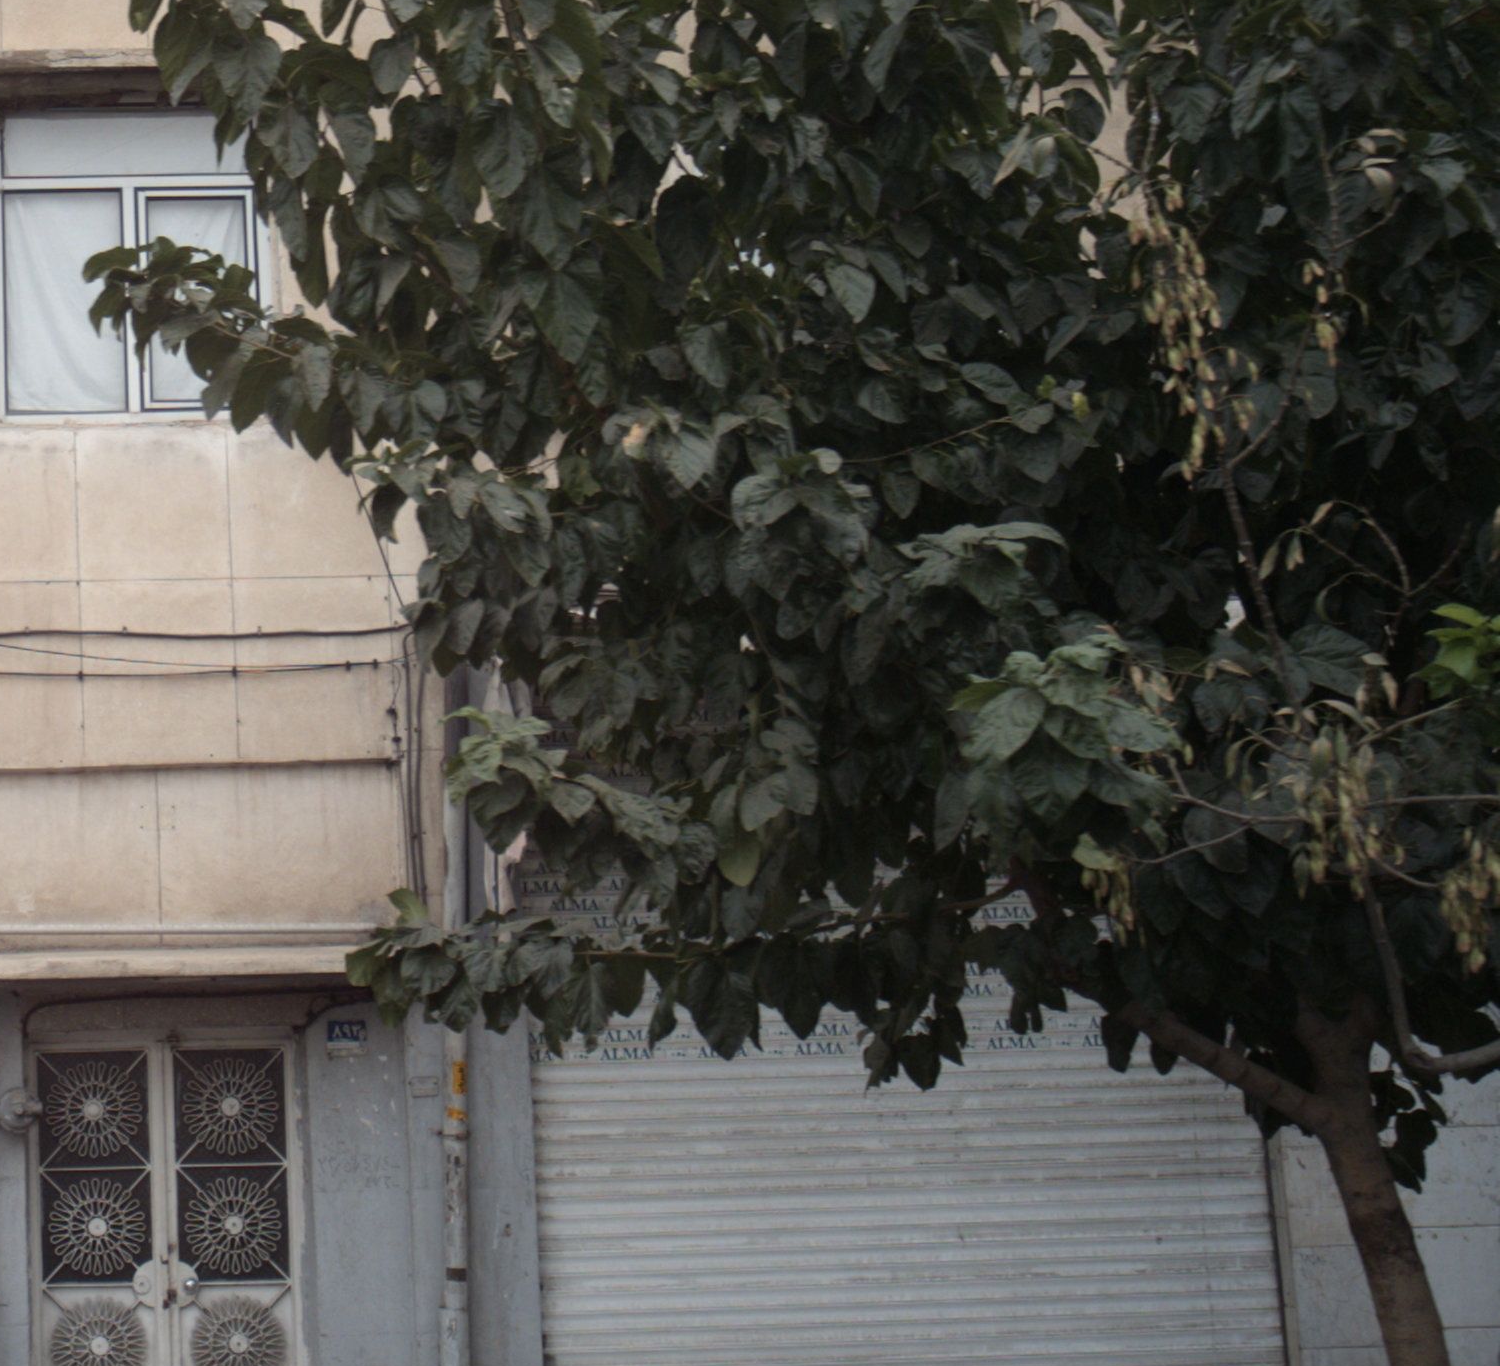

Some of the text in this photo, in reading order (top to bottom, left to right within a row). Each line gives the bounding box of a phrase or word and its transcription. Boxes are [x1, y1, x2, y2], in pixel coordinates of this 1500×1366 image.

[980, 906, 1031, 920] ALMA
[600, 1047, 651, 1060] ALMA
[793, 1041, 844, 1056] ALMA
[987, 1036, 1037, 1050] ALMA
